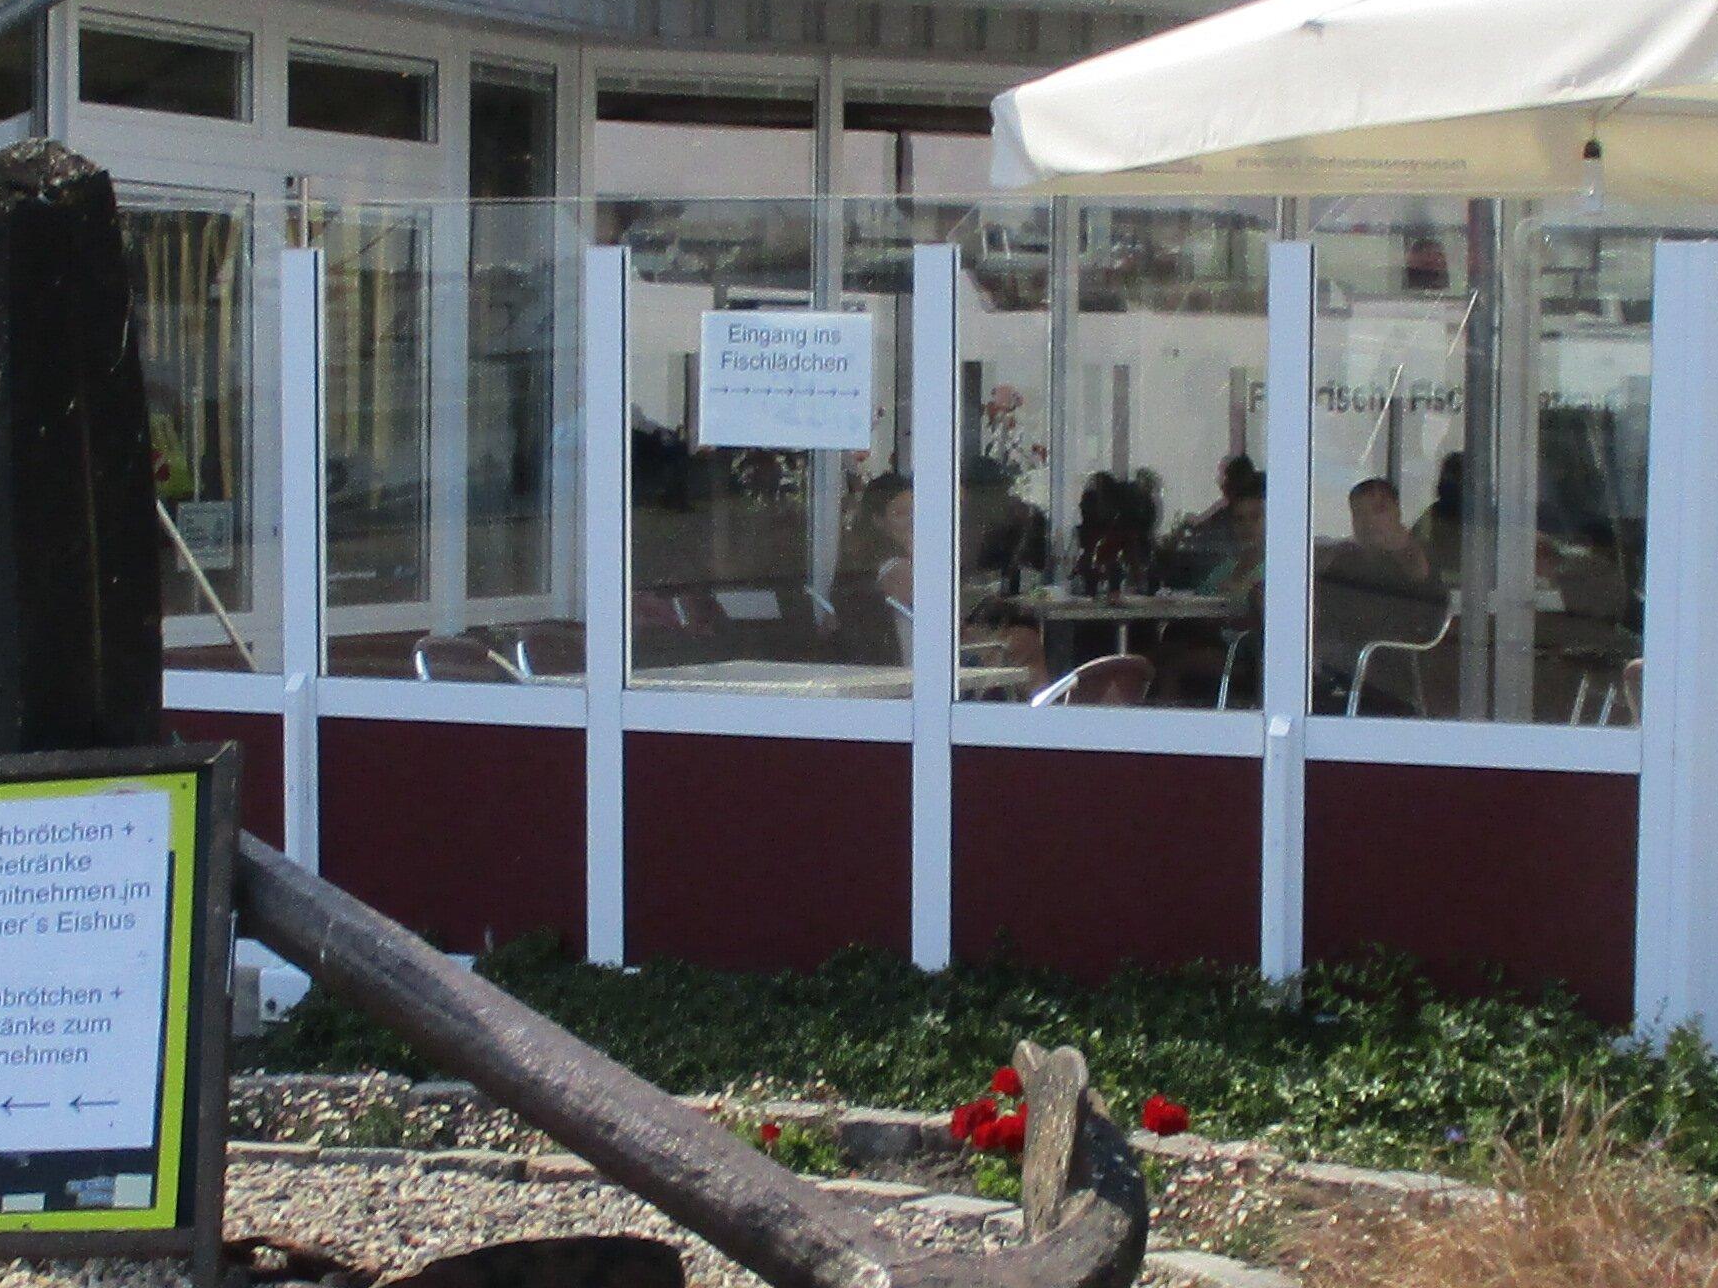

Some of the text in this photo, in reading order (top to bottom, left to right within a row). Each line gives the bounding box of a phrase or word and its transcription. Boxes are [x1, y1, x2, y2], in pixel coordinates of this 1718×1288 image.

[728, 323, 842, 349] Eingang ins
[721, 351, 848, 372] Fischlädchen
[121, 820, 134, 836] +
[56, 910, 137, 934] Eishus
[110, 986, 123, 1000] +
[62, 1016, 112, 1035] zum
